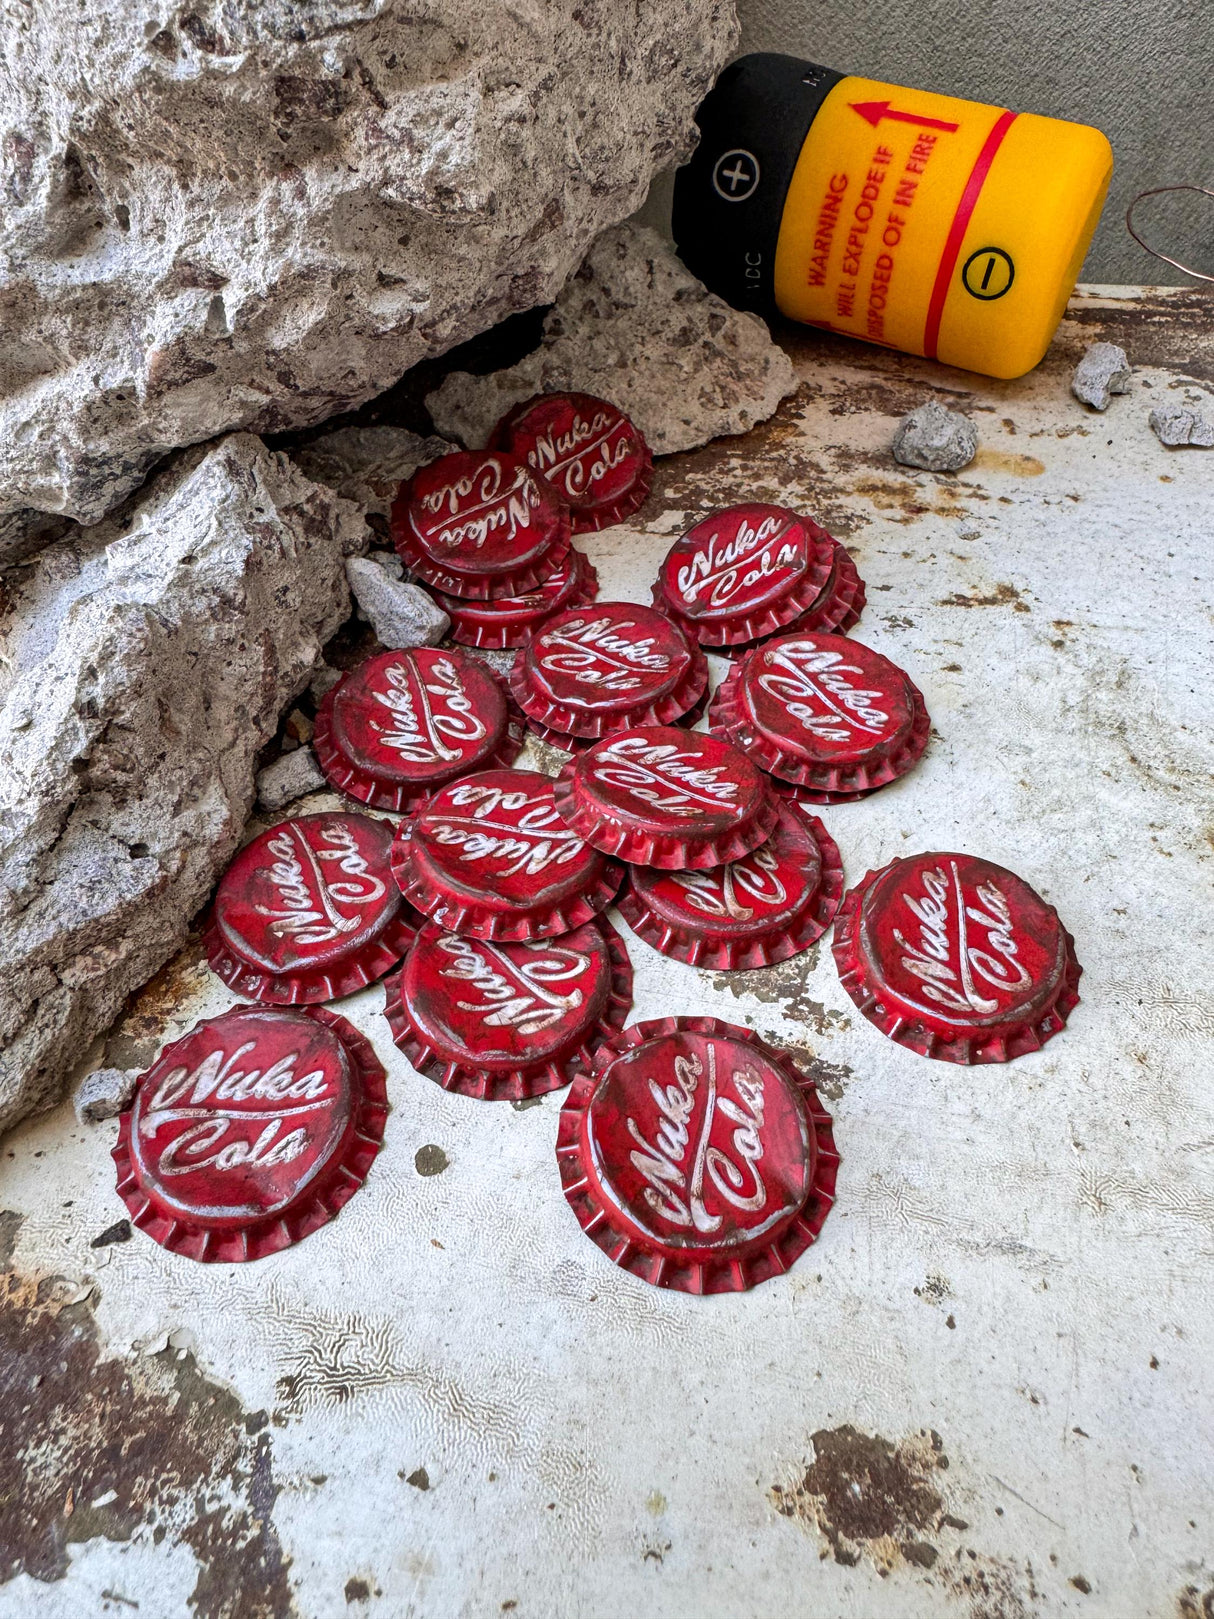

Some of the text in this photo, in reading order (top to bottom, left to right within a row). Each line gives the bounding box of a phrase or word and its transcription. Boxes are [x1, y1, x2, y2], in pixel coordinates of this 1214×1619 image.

[905, 133, 937, 174] FIRE
[893, 179, 918, 207] IN
[808, 173, 848, 287] WARNING
[837, 145, 893, 317] WILL EXPLODE IF
[883, 211, 906, 247] OF
[528, 412, 612, 469] Nuka
[565, 438, 632, 497] Cola
[421, 458, 502, 514] Cola
[438, 474, 541, 548] Nuka
[678, 516, 782, 590] Nuka
[710, 541, 797, 607] Cola
[541, 653, 642, 690] Cola
[550, 618, 671, 670] Nuka
[369, 661, 438, 763] Nuka
[426, 657, 487, 741] Cola
[758, 674, 850, 742] Cola
[776, 640, 889, 728] Nuka
[594, 768, 703, 816] Cola
[607, 738, 739, 799] Nuka
[316, 823, 385, 903] Cola
[431, 825, 585, 877] Nuka
[254, 832, 340, 944] Nuka
[892, 866, 972, 1013] Nuka
[967, 879, 1033, 993] Cola
[147, 1041, 331, 1112] Nuka
[159, 1119, 314, 1176] Cola
[627, 1053, 704, 1226] Nuka
[707, 1062, 767, 1213] Cola
